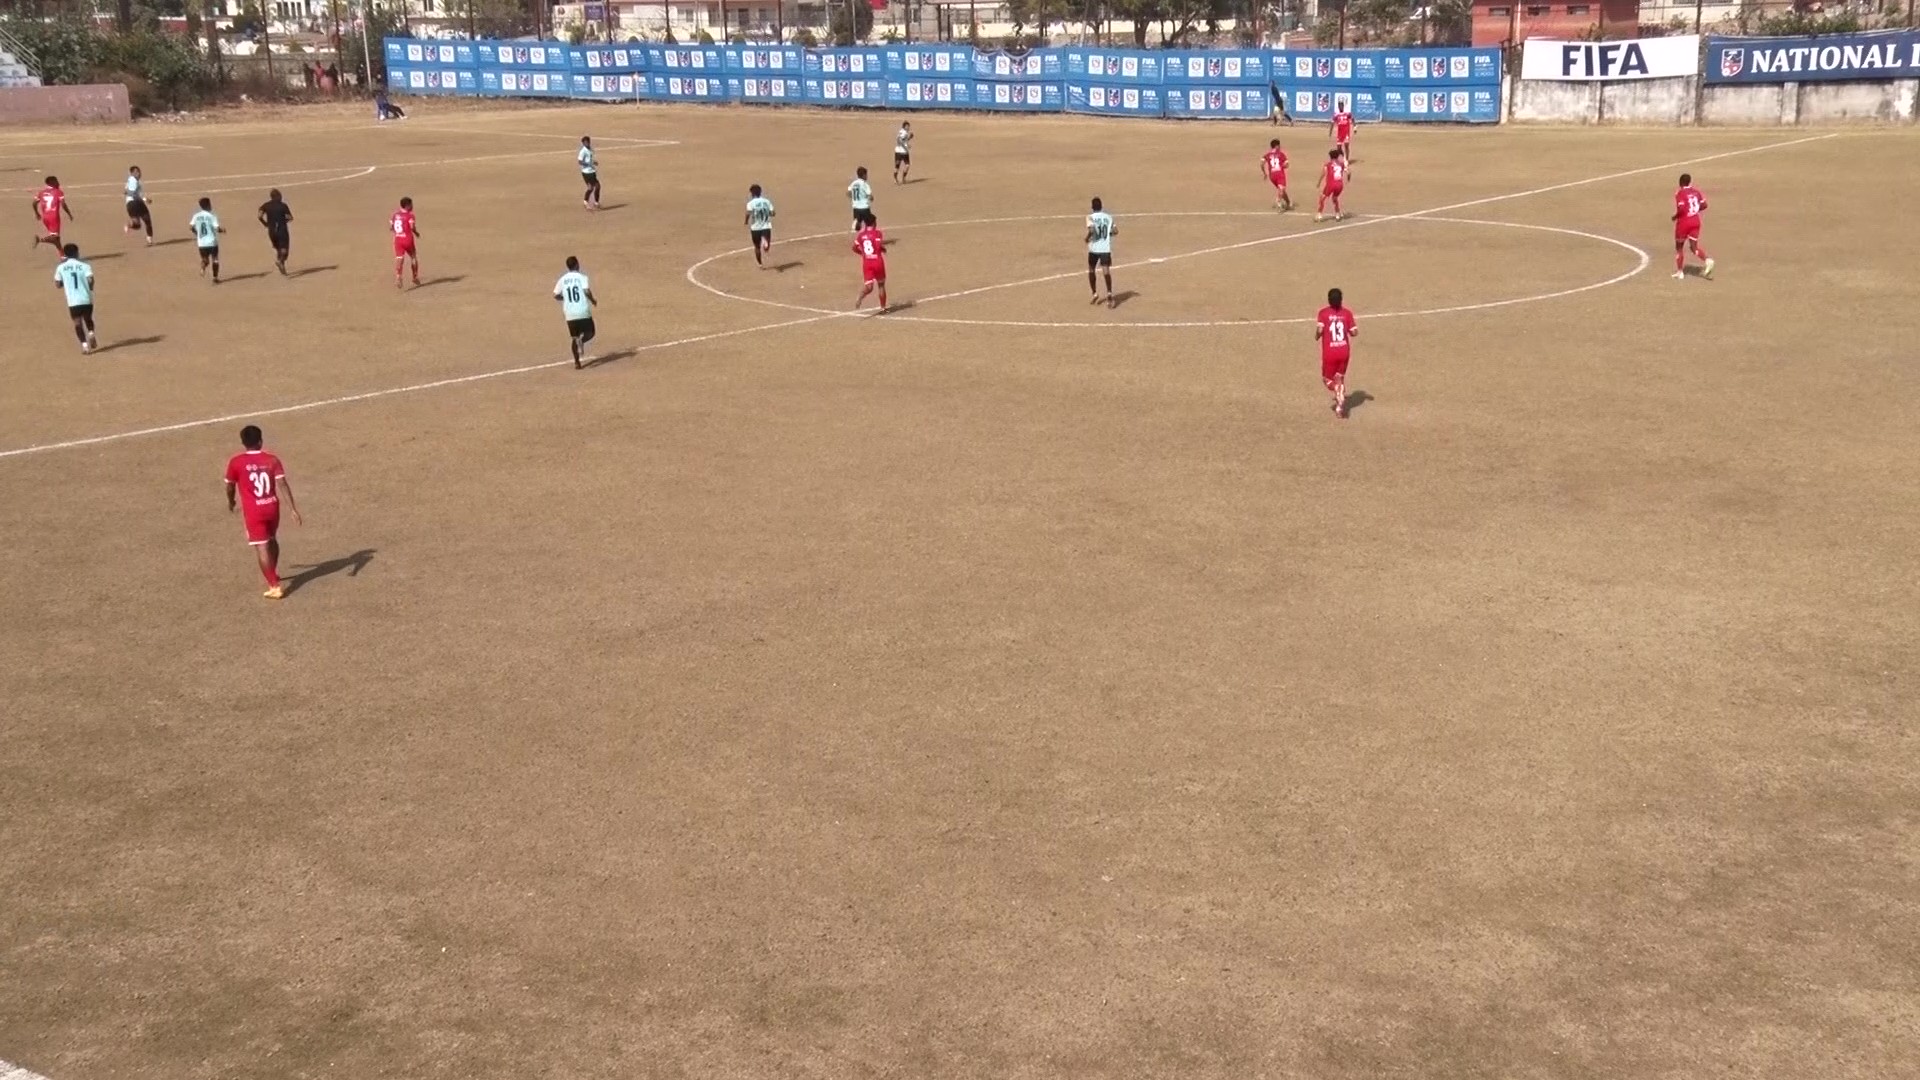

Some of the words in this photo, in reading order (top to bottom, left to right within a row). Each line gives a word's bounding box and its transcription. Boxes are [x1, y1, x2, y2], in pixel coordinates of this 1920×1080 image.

[1069, 53, 1081, 61] FIFA
[1273, 56, 1287, 64] FIFA
[1474, 56, 1490, 64] FIFA
[1562, 43, 1649, 76] FIFA
[1751, 44, 1901, 73] NATIONAL
[1069, 86, 1082, 94] FIFA
[1386, 92, 1401, 100] FIFA
[43, 196, 54, 211] 7
[863, 239, 874, 255] 8
[71, 272, 78, 289] 1
[566, 286, 580, 303] 16
[1329, 321, 1344, 342] 13
[249, 471, 270, 497] 30
